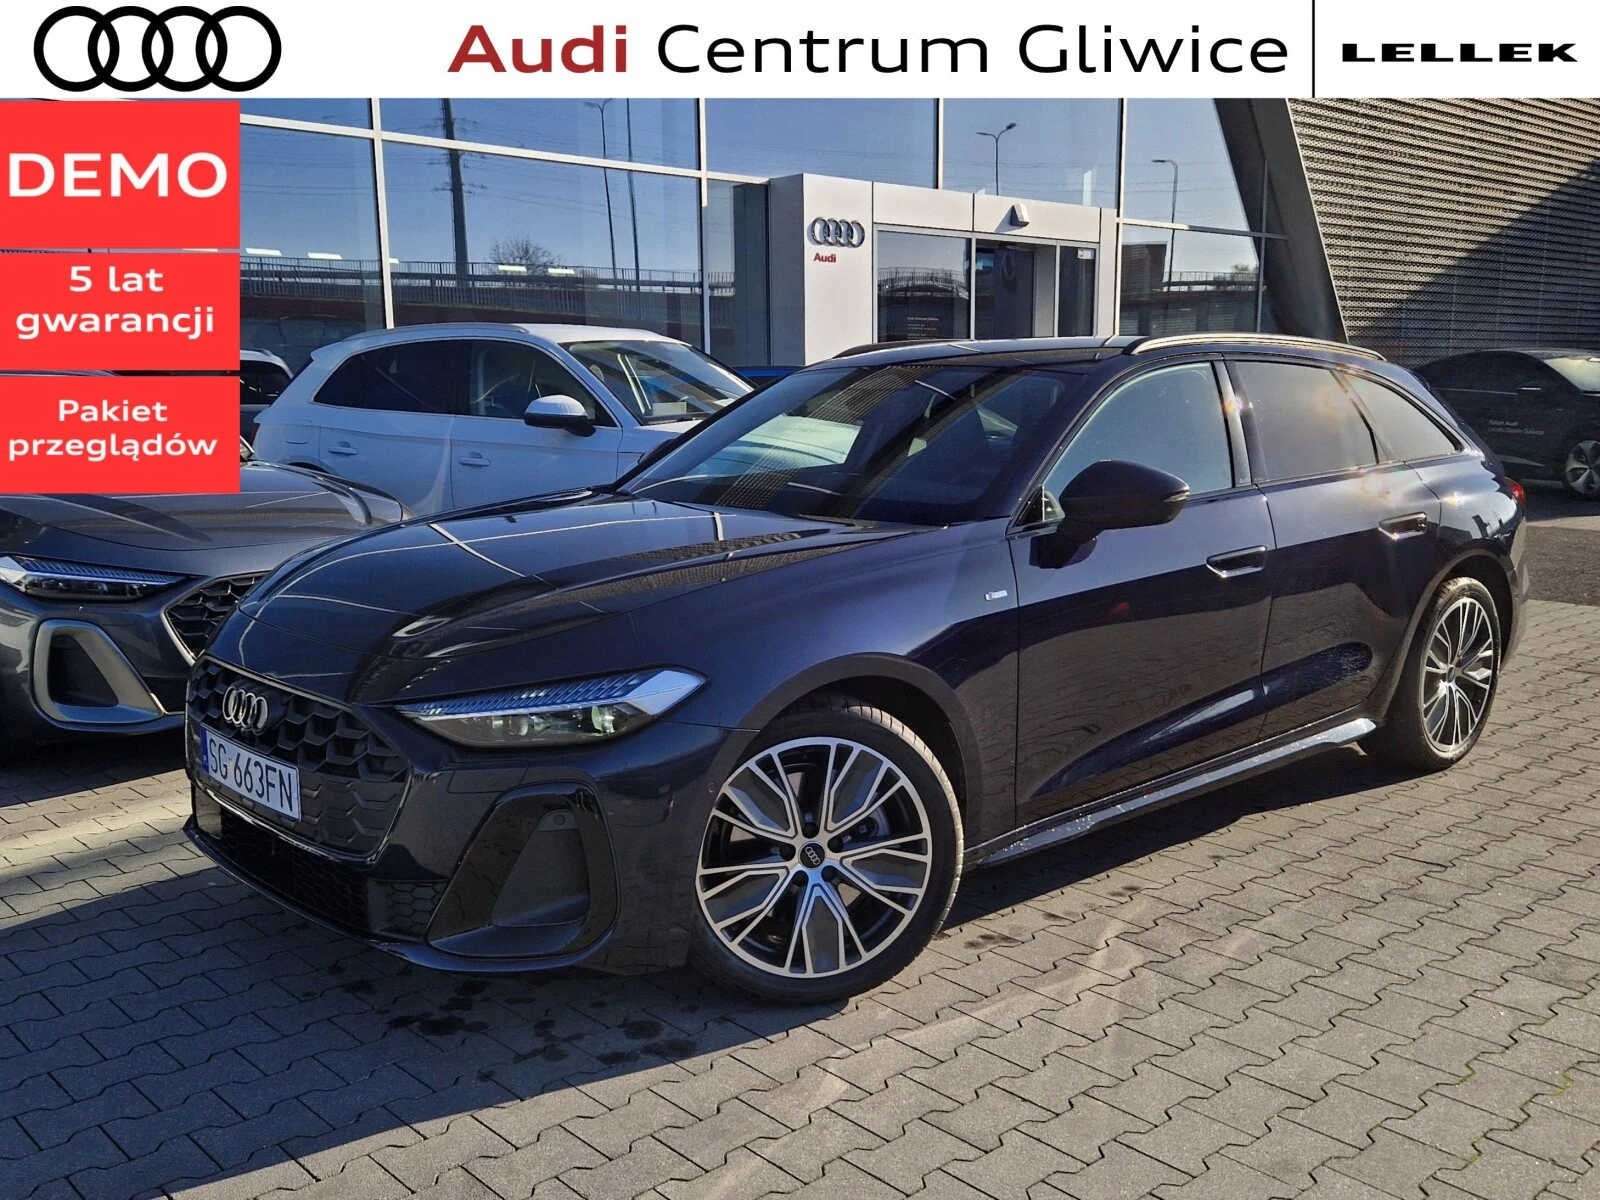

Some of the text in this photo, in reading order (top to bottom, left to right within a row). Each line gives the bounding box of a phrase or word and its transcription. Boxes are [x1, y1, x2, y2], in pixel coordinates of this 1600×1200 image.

[813, 252, 837, 263] Audi
[209, 737, 293, 812] SG 663FN
